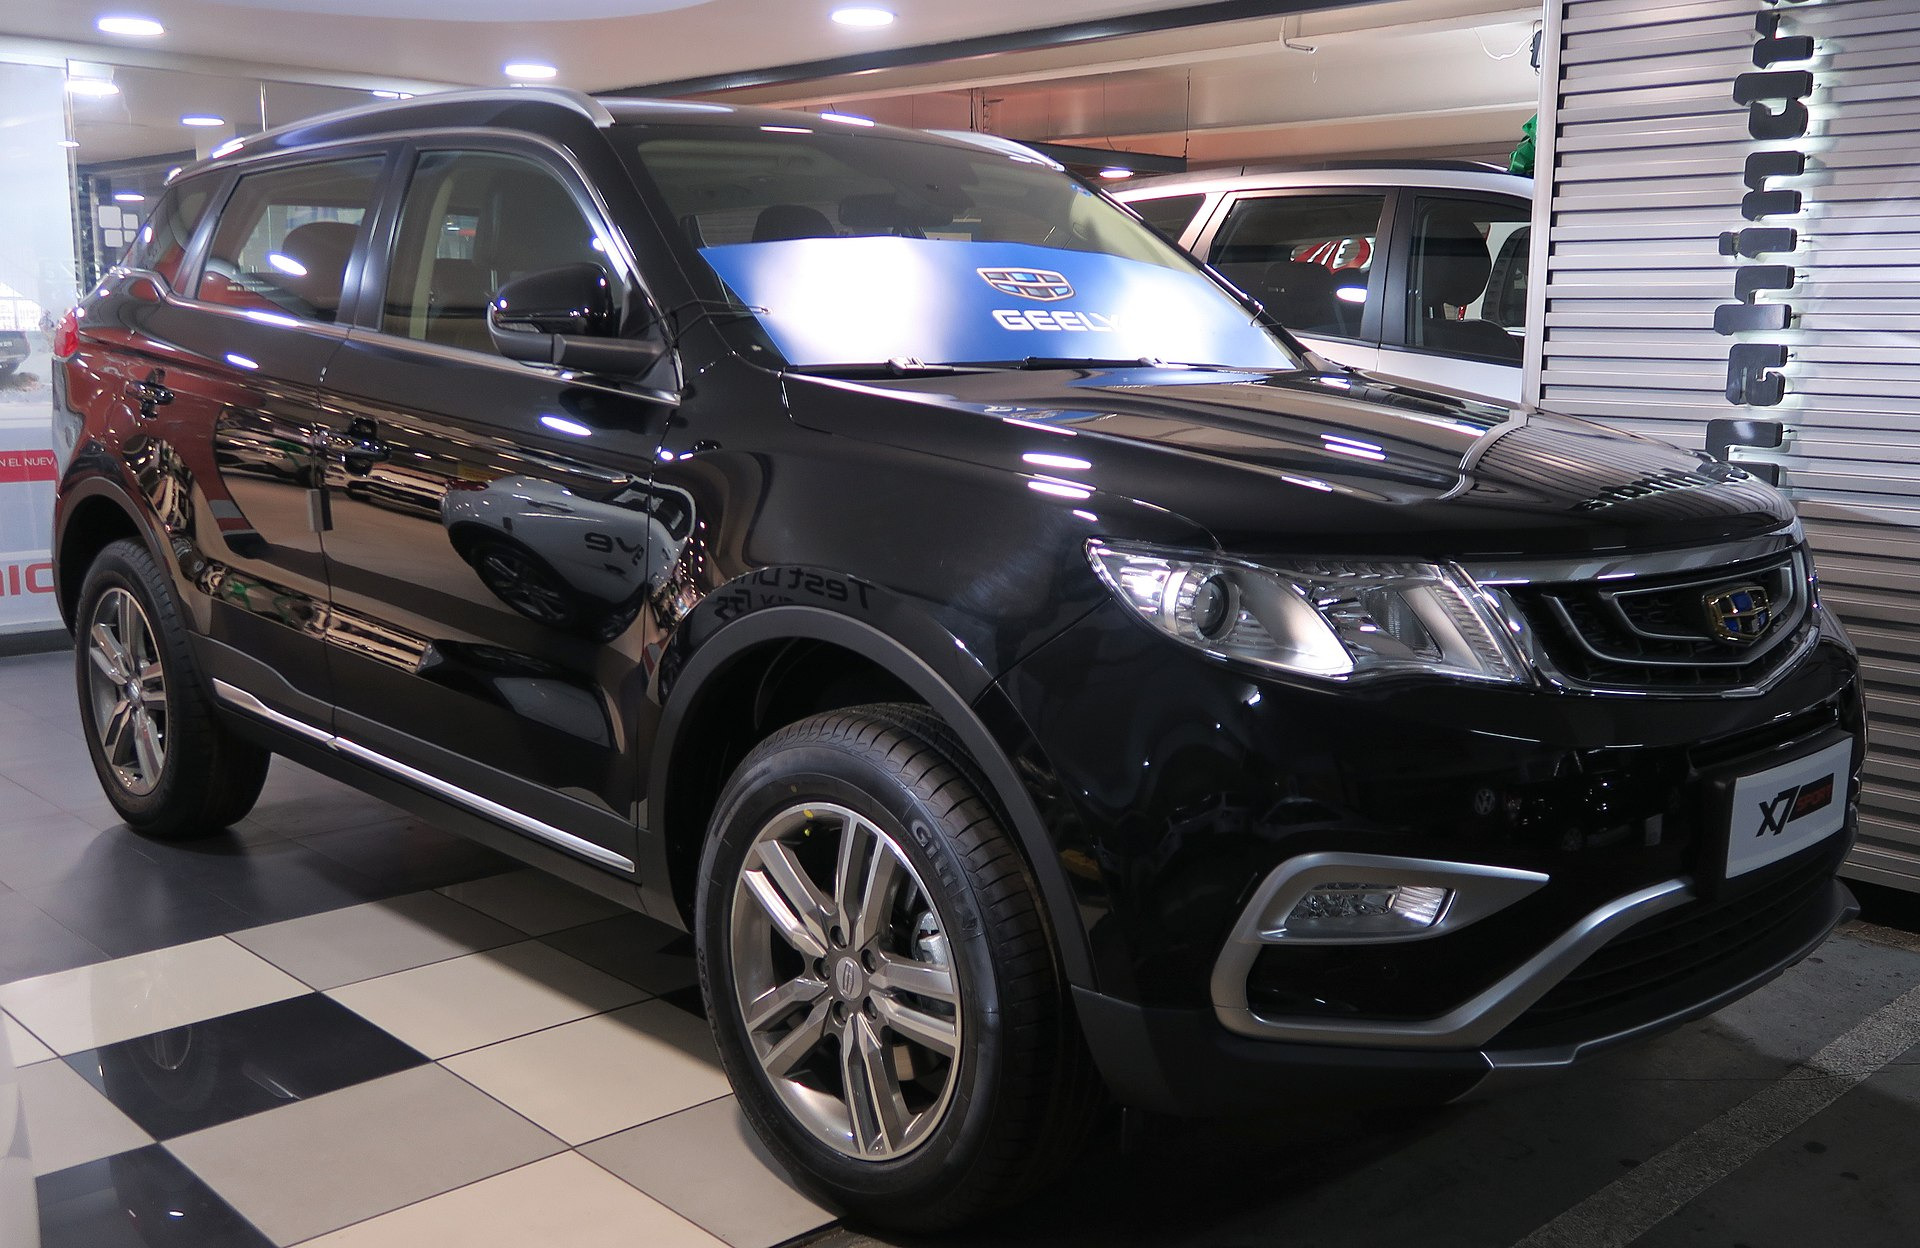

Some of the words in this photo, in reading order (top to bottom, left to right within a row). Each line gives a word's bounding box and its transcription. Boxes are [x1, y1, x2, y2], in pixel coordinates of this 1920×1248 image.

[1705, 0, 1814, 487] ahindr
[9, 458, 21, 467] EL
[1756, 785, 1800, 837] X7
[911, 818, 957, 888] Giti
